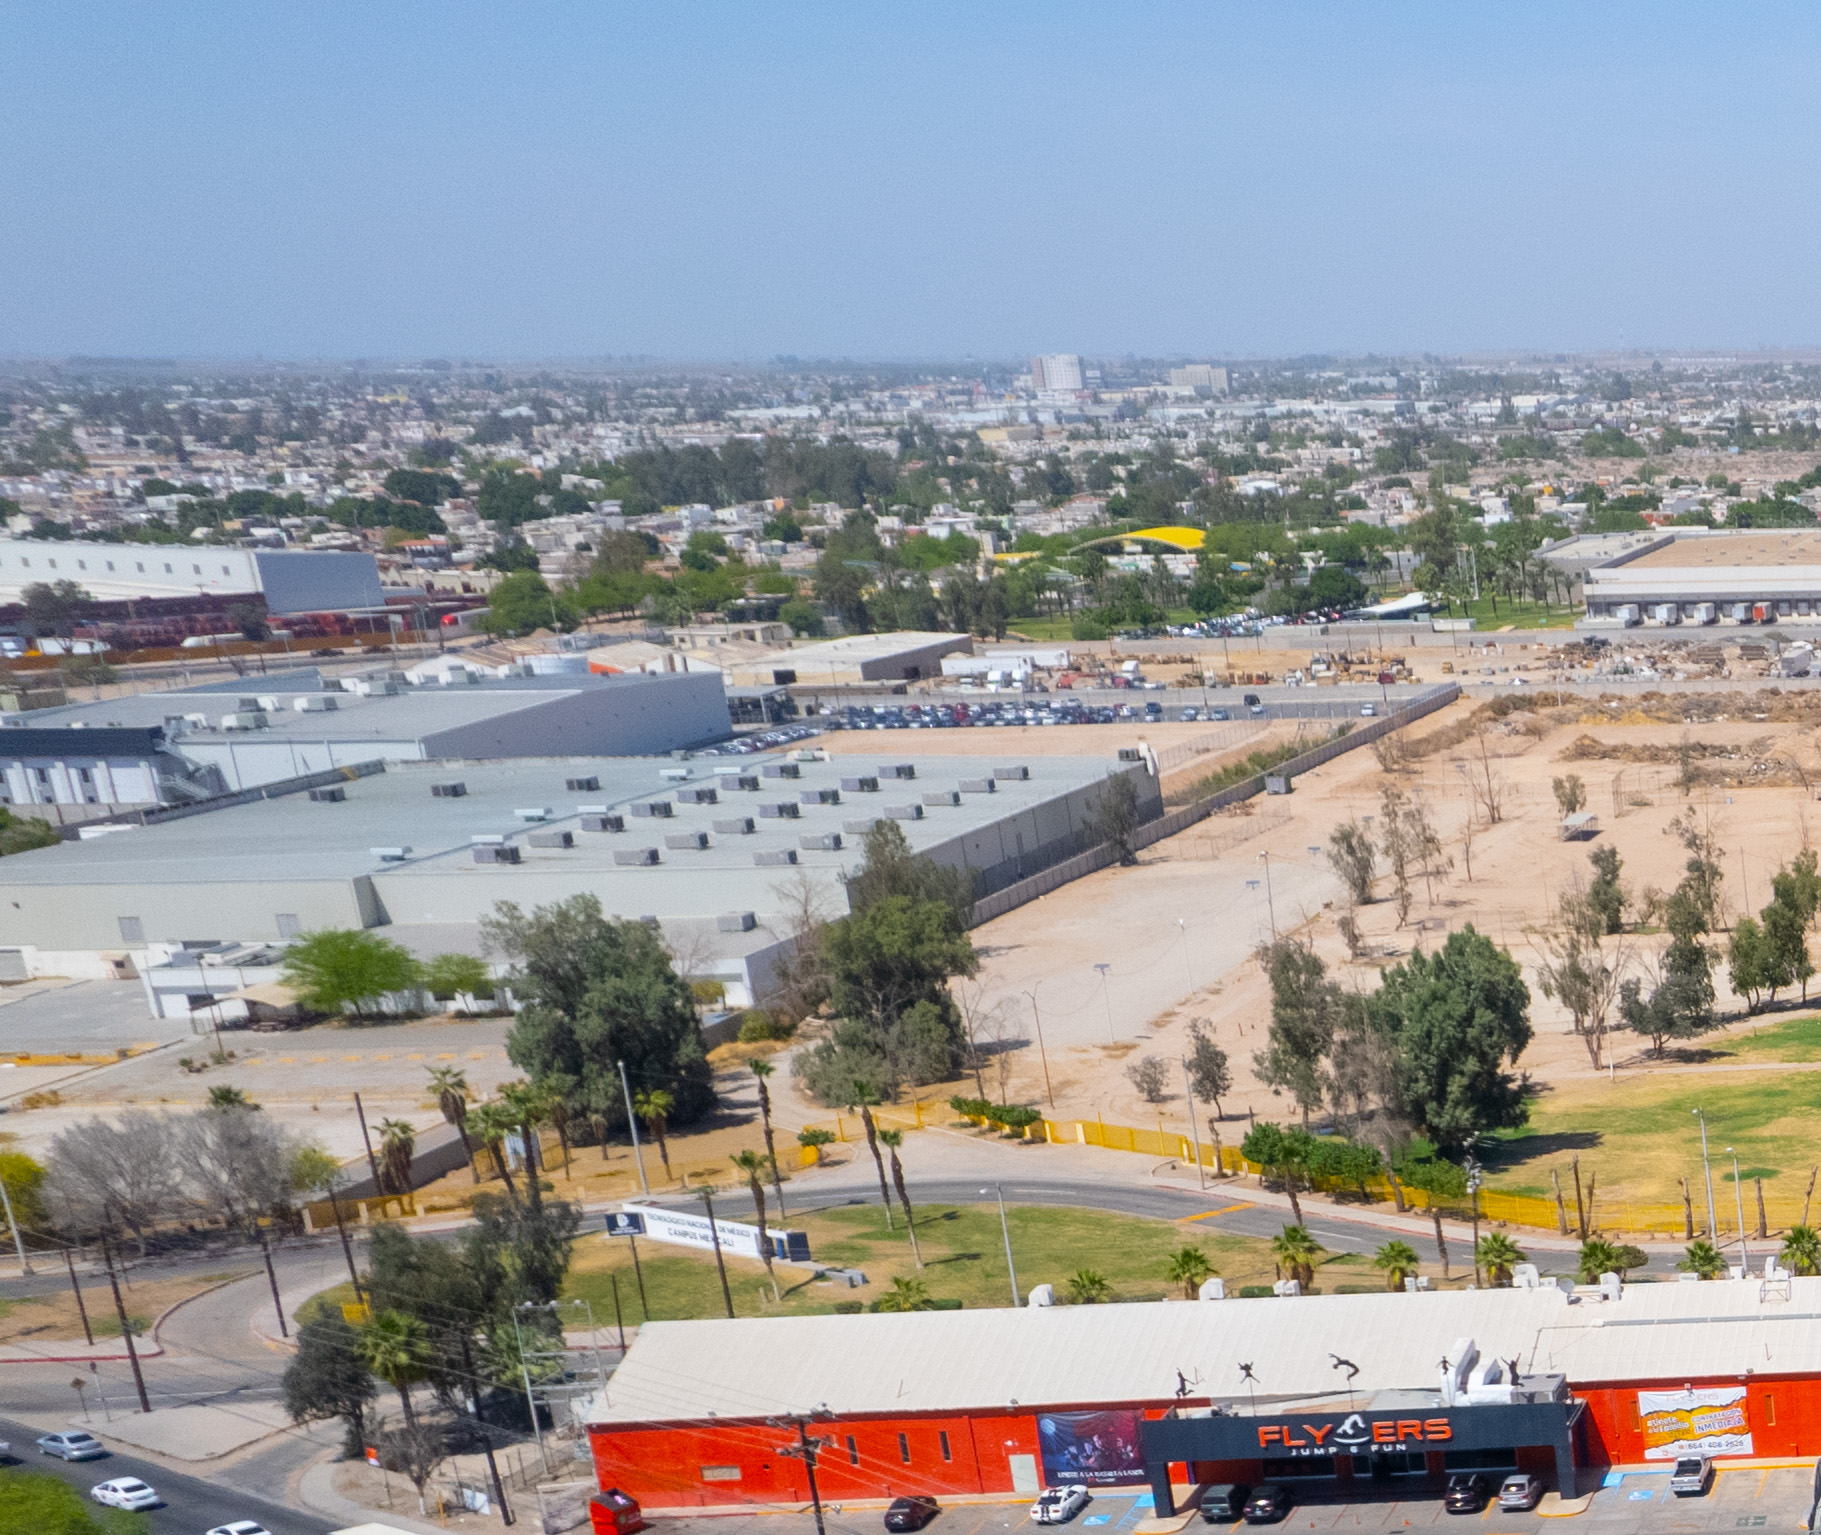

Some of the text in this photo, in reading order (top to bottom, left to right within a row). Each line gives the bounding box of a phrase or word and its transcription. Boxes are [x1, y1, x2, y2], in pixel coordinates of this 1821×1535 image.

[668, 1227, 698, 1241] CAMPUS
[1694, 1417, 1745, 1433] INMEDIATA
[1291, 1446, 1338, 1455] JUMP
[1371, 1443, 1407, 1451] FUN
